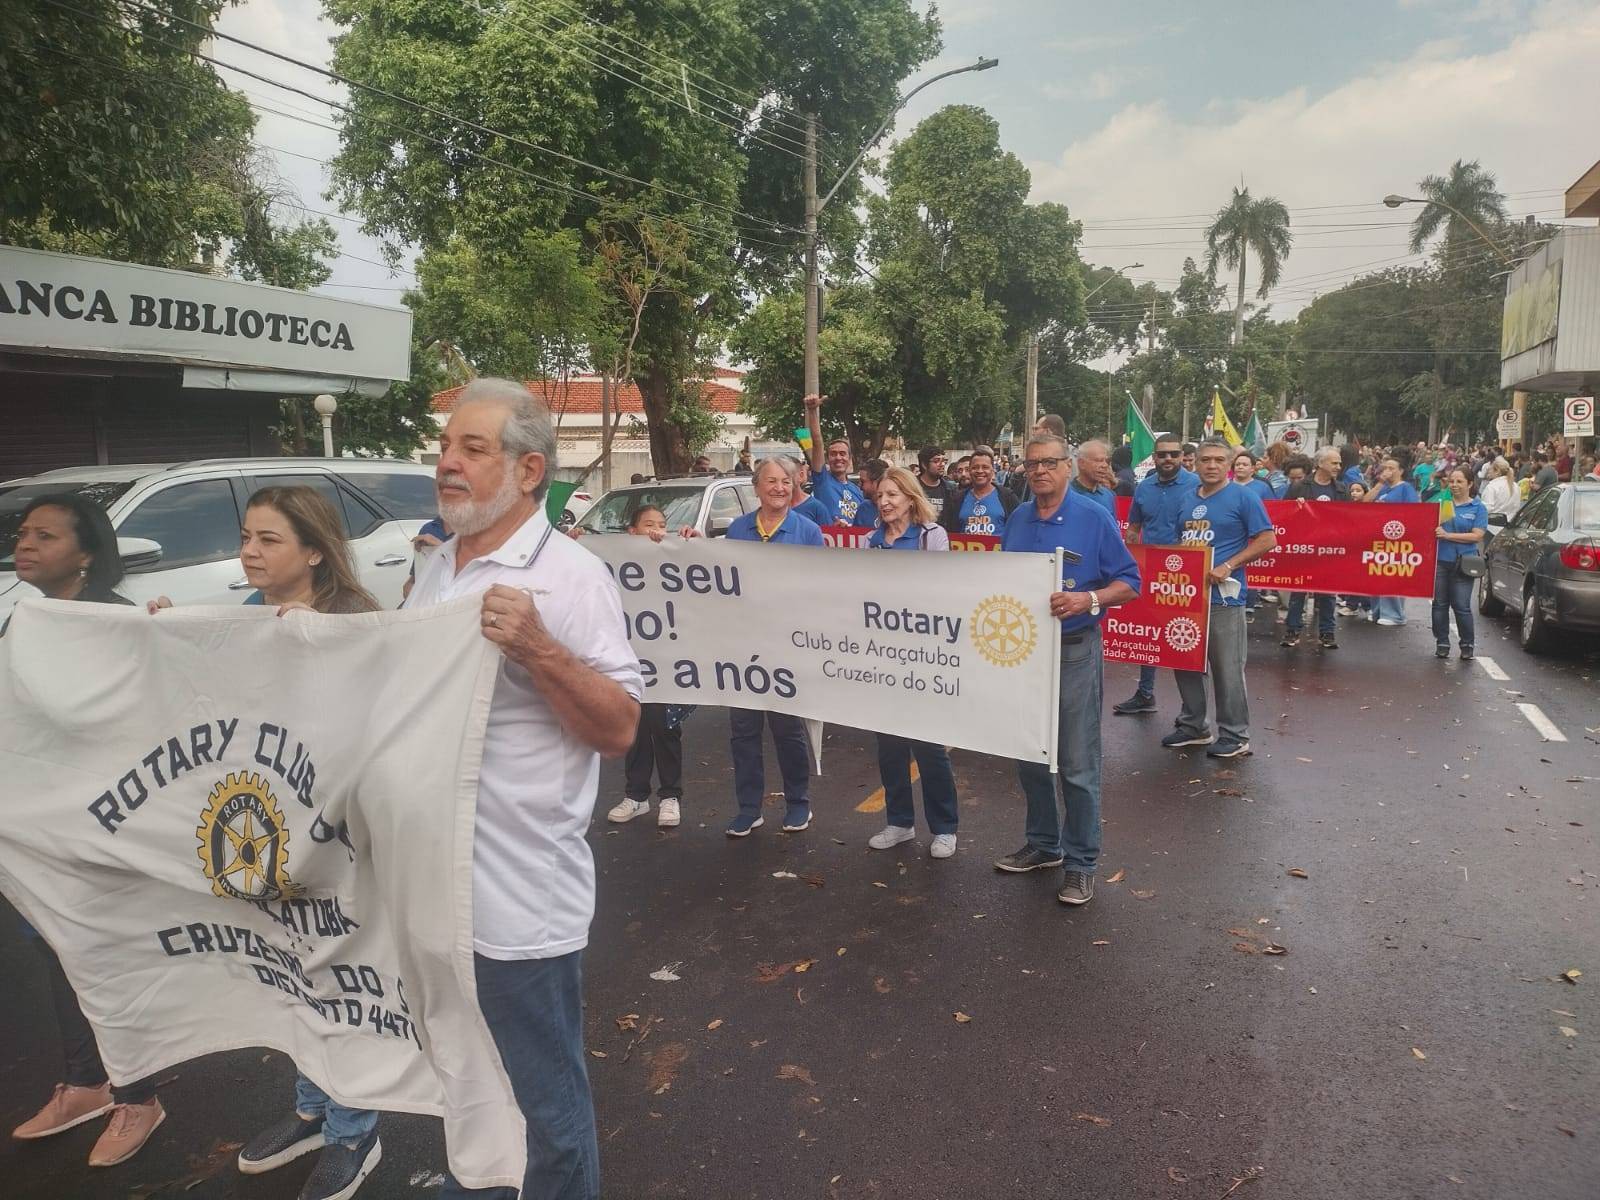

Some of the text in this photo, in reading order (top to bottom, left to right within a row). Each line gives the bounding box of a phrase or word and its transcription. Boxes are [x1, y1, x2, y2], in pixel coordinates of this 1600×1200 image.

[129, 294, 355, 351] BIBLIOTECA
[1573, 403, 1586, 416] E
[964, 523, 996, 533] POLIO
[1185, 520, 1211, 530] END
[1181, 529, 1216, 541] POLIO
[1285, 543, 1315, 554] 1985
[1318, 546, 1346, 556] para
[1373, 541, 1414, 554] END
[1362, 551, 1423, 566] POLIO
[1157, 571, 1191, 584] END
[1369, 563, 1415, 577] NOW
[659, 562, 741, 596] seu
[1274, 575, 1292, 585] em
[1294, 575, 1304, 585] si
[1150, 581, 1197, 597] POLIO
[1155, 592, 1192, 607] NOW
[863, 601, 962, 644] Rotary
[1107, 618, 1161, 641] Rotary
[791, 630, 832, 651] Club
[838, 635, 860, 655] de
[865, 639, 960, 668] Araçatuba
[1111, 638, 1161, 653] Araçatuba
[1128, 651, 1160, 664] Amiga
[673, 659, 701, 689] a
[714, 654, 797, 699] nós
[822, 660, 960, 697] Cruzeiro do Sul
[87, 718, 239, 834] ROTARY
[254, 722, 316, 808] CLUB
[223, 796, 269, 822] ROTARY
[330, 964, 385, 998] DO
